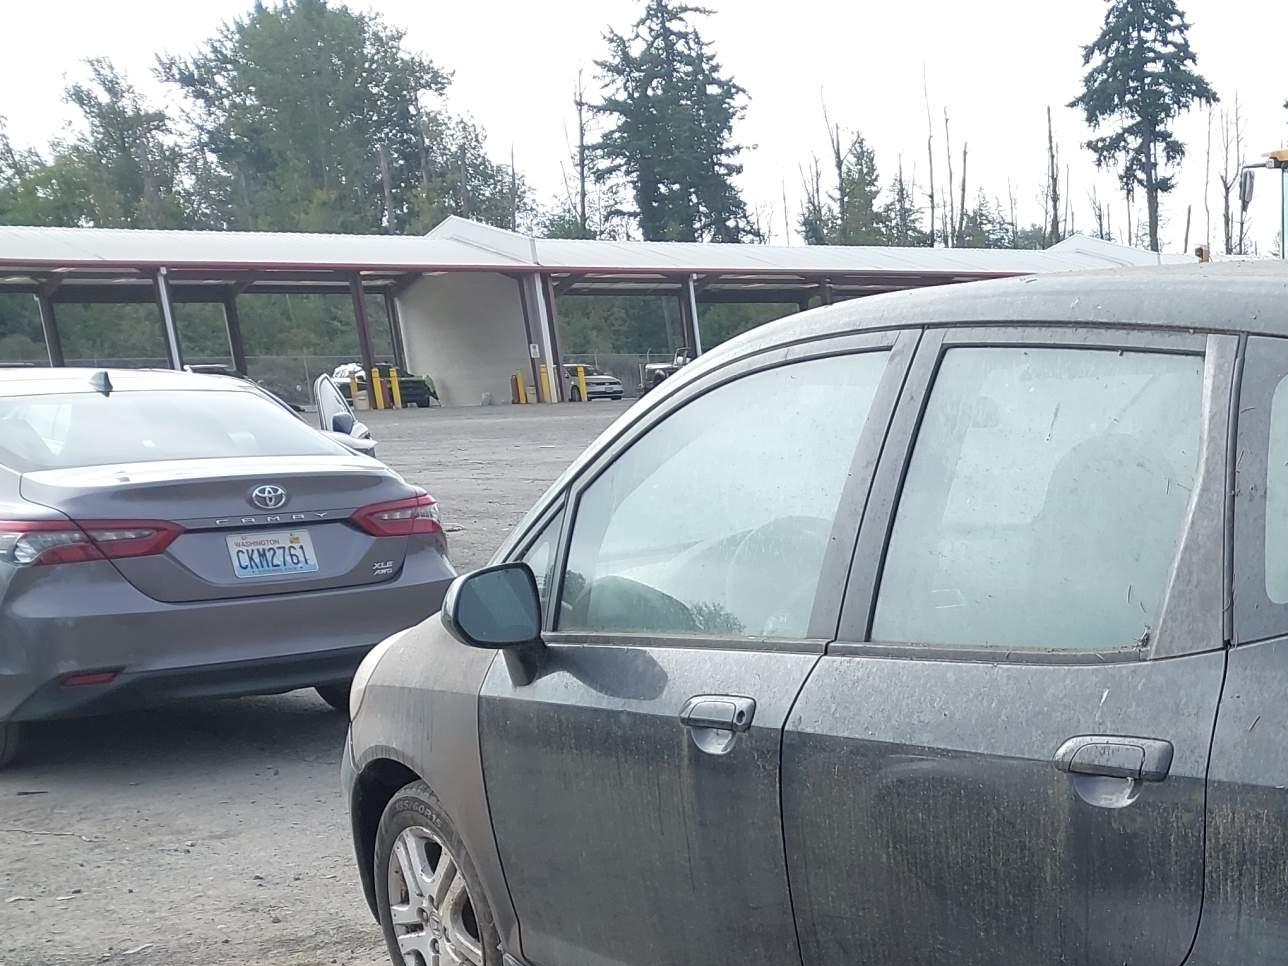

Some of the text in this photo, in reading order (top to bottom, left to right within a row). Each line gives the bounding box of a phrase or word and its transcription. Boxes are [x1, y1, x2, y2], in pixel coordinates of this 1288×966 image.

[215, 512, 328, 526] CAMRY
[234, 538, 280, 549] WASHINGTON
[236, 544, 309, 570] CKM2761
[372, 560, 393, 570] XLE
